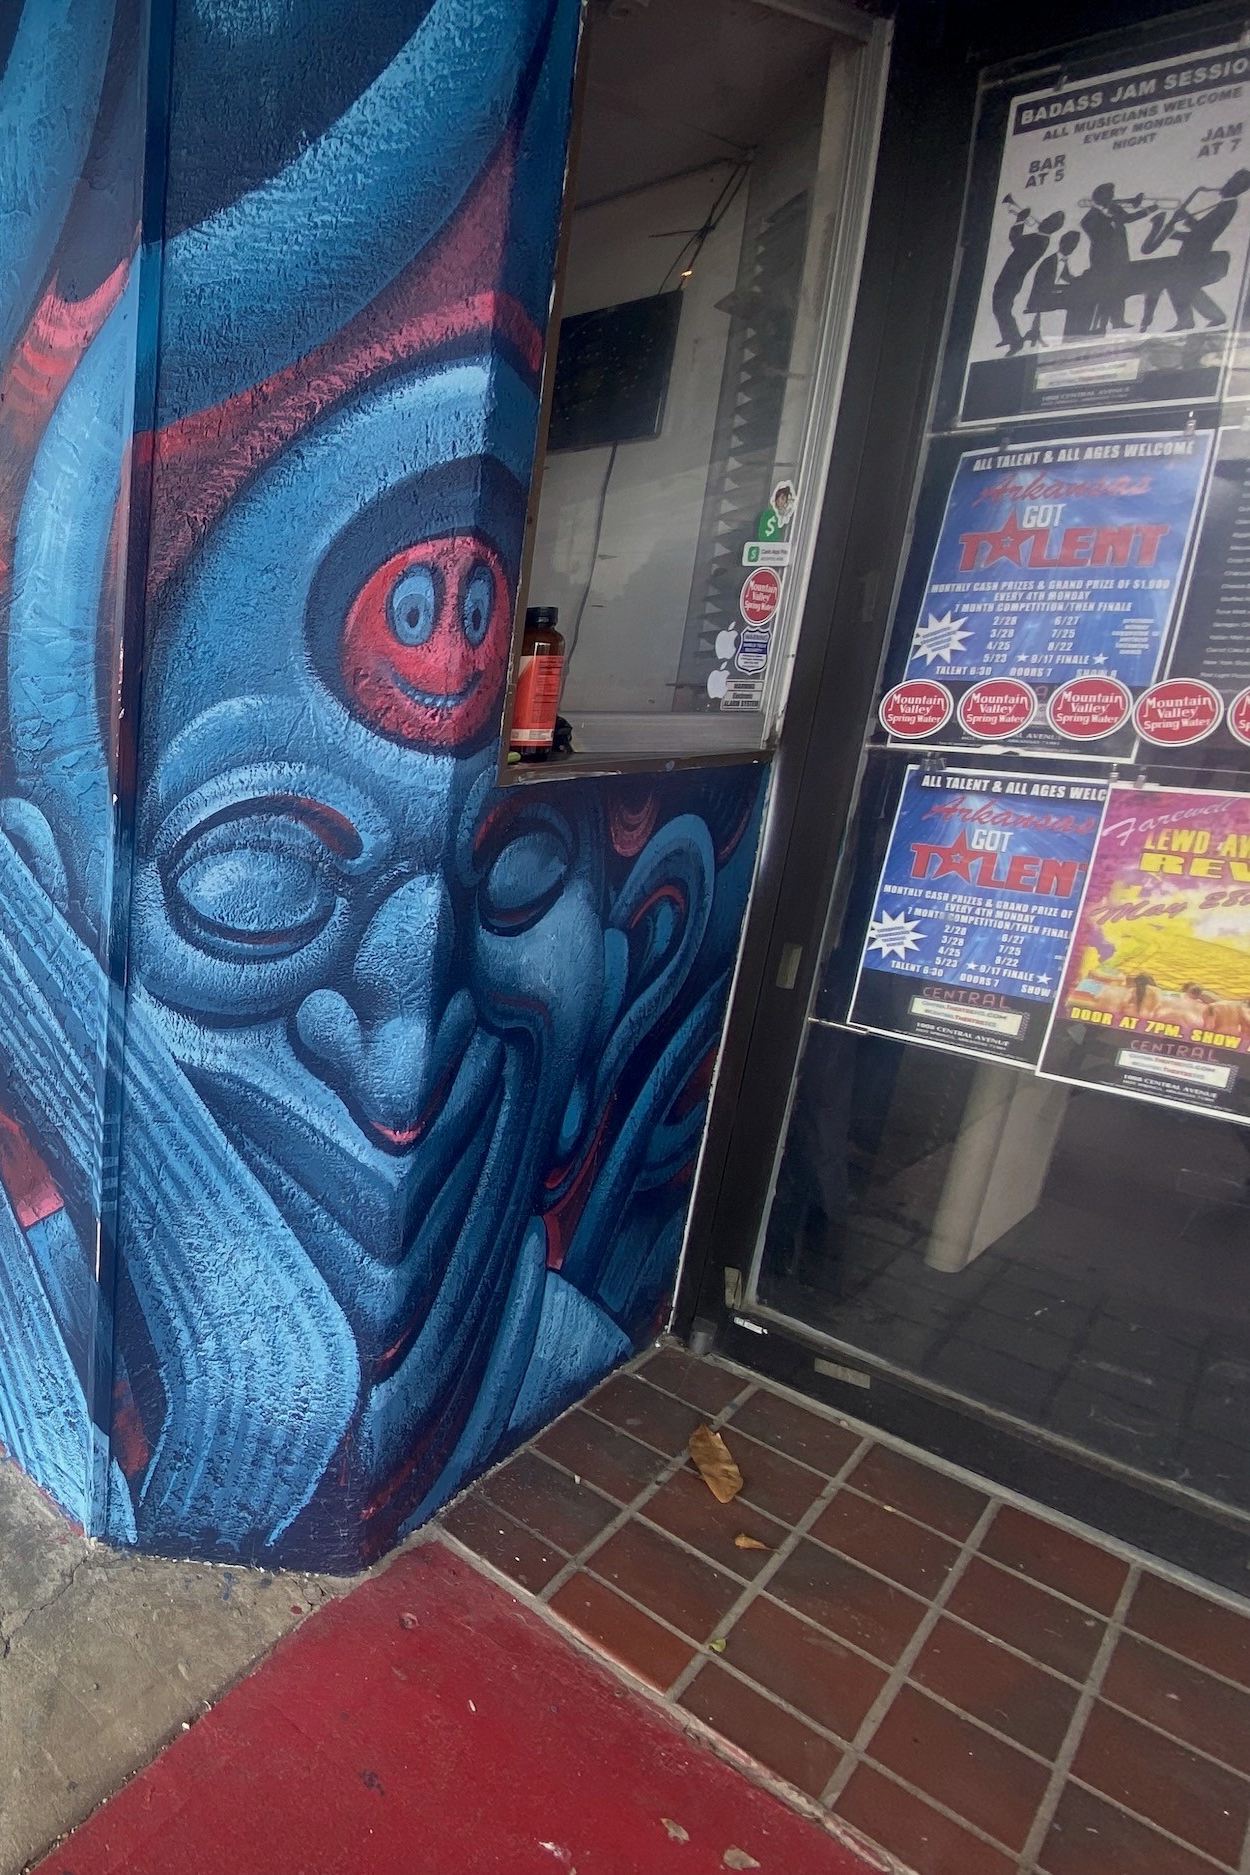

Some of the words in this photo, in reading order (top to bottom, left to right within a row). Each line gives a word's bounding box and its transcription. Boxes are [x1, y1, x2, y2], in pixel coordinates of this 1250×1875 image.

[1021, 92, 1103, 125] BADASS
[1110, 78, 1156, 103] JAM
[1043, 127, 1069, 141] ALL
[1074, 106, 1158, 133] MUSICIANS
[1164, 86, 1243, 113] WELCOME
[1083, 126, 1128, 144] EVERY
[1132, 112, 1192, 133] MONDAY
[1201, 121, 1244, 142] JAM
[1112, 132, 1157, 150] NIGHT
[1197, 141, 1223, 158] AT
[1230, 138, 1242, 153] 7
[1028, 154, 1066, 173] BAR
[1025, 172, 1048, 188] AT
[1054, 169, 1065, 182] 5
[972, 458, 992, 472] ALL
[997, 451, 1041, 469] TALENT
[1043, 449, 1054, 464] &
[1057, 446, 1080, 463] ALL
[1084, 444, 1121, 460] AGES
[1124, 440, 1195, 458] WELCOME
[971, 471, 1152, 508] Arkansas
[1022, 503, 1067, 529] GOT
[931, 583, 971, 594] MONTHLY
[973, 582, 999, 593] CASH
[1001, 581, 1035, 592] PRIZES
[1037, 580, 1046, 591] &
[1049, 580, 1084, 591] GRAND
[1086, 579, 1115, 590] PRIZE
[1117, 579, 1131, 590] OF
[994, 592, 1023, 602] EVERY
[1025, 591, 1046, 602] 4TH
[1049, 590, 1092, 602] MONDAY
[954, 602, 961, 613] 7
[961, 602, 995, 613] MONTH
[996, 601, 1096, 613] COMPETITION/THEN
[1097, 601, 1133, 612] FINALE
[993, 615, 1018, 626] 2/28
[1054, 616, 1080, 626] 6/27
[989, 628, 1015, 639] 3/28
[1051, 628, 1076, 639] 7/25
[985, 641, 1011, 651] 4/25
[982, 653, 1007, 664] 5/23
[1030, 654, 1054, 664] 9/17
[1055, 654, 1090, 665] FINALE
[935, 666, 968, 676] TALENT
[1009, 667, 1045, 678] DOORS
[1046, 667, 1053, 678] 7
[1076, 668, 1106, 678] SHOW
[888, 693, 946, 712] Mountain
[900, 704, 933, 716] Valley
[967, 692, 1029, 712] Mountain
[979, 703, 1017, 716] Valley
[1057, 690, 1125, 711] Mountain
[1070, 702, 1110, 715] Valley
[1143, 695, 1216, 718] Mountain
[887, 713, 916, 725] Spring
[917, 713, 942, 723] Water
[966, 713, 999, 725] Spring
[999, 714, 1025, 724] Water
[1056, 713, 1090, 725] Spring
[1091, 714, 1120, 724] Water
[1157, 705, 1198, 719] Valley
[1144, 719, 1180, 731] Spring
[1181, 717, 1212, 729] Water
[921, 774, 942, 788] ALL
[946, 776, 991, 792] TALENT
[992, 780, 1003, 793] &
[1005, 781, 1028, 795] ALL
[1031, 783, 1066, 799] AGES
[922, 794, 1095, 836] Arkansas
[1101, 797, 1240, 846] Farewell
[970, 829, 1014, 852] GOT
[1144, 828, 1211, 854] LEWD
[910, 829, 1088, 898] TALEN
[883, 884, 923, 897] MONTHLY
[925, 888, 949, 901] CASH
[950, 892, 983, 906] PRIZES
[986, 898, 994, 907] &
[995, 899, 1030, 913] GRAND
[1031, 904, 1059, 916] PRIZE
[1061, 909, 1074, 919] OF
[907, 906, 913, 915] 7
[914, 907, 945, 921] MONTH
[948, 912, 1040, 935] COMPETITION/THEN
[1041, 926, 1071, 940] FINAL
[945, 903, 973, 915] EVERY
[974, 907, 993, 918] 4TH
[995, 909, 1036, 924] MONDAY
[1090, 900, 1188, 926] May
[943, 924, 967, 936] 2/28
[1001, 933, 1025, 945] 6/27
[938, 945, 961, 958] 4/25
[995, 955, 1019, 968] 8/22
[941, 935, 965, 947] 3/28
[998, 944, 1022, 957] 7/25
[890, 960, 921, 974] TALENT
[922, 965, 944, 978] 6:30
[959, 972, 992, 987] DOORS
[993, 978, 1000, 988] 7
[1020, 984, 1051, 997] SHOW
[935, 956, 958, 968] 5/23
[979, 964, 1001, 976] 9/17
[1002, 969, 1035, 982] FINALE
[922, 986, 1011, 1010] CENTRAL
[936, 1026, 973, 1039] CENTRAL
[974, 1035, 1010, 1047] AVENUE
[1070, 1006, 1113, 1026] DOOR
[1118, 1015, 1139, 1030] AT
[1144, 1019, 1183, 1039] 7PM.
[1191, 1028, 1242, 1049] SHOW
[1130, 1038, 1220, 1063] CENTRAL
[1144, 1076, 1180, 1091] CENTRAL
[1184, 1085, 1218, 1099] AVENUE
